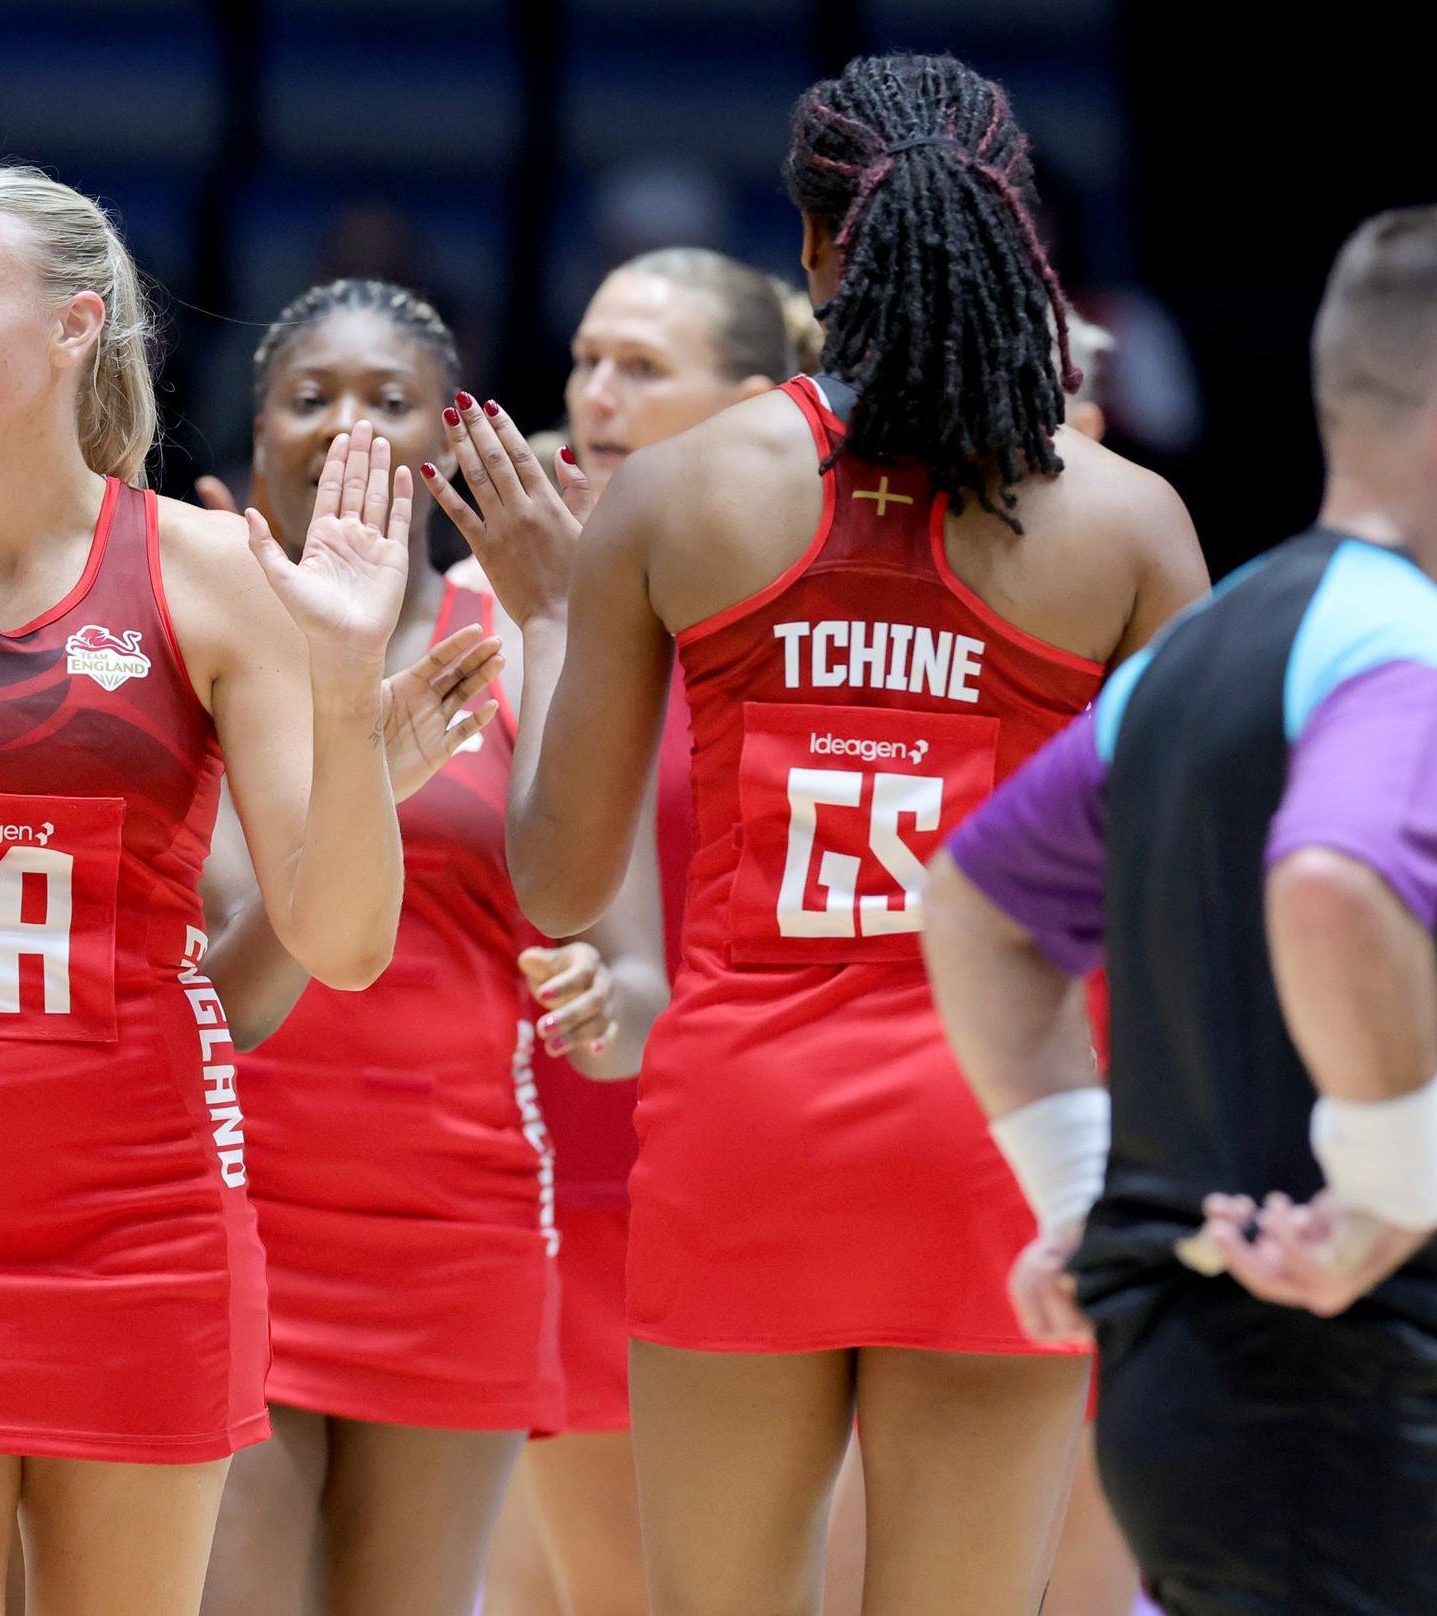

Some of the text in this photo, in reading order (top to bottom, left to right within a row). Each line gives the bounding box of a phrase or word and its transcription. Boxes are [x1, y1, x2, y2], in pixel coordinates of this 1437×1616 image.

[71, 659, 145, 674] ENGLAND
[79, 652, 108, 660] TEAM
[773, 620, 985, 703] TCHINE
[810, 733, 907, 762] Ideagen
[776, 767, 944, 938] GS
[178, 924, 247, 1189] ENGLAND
